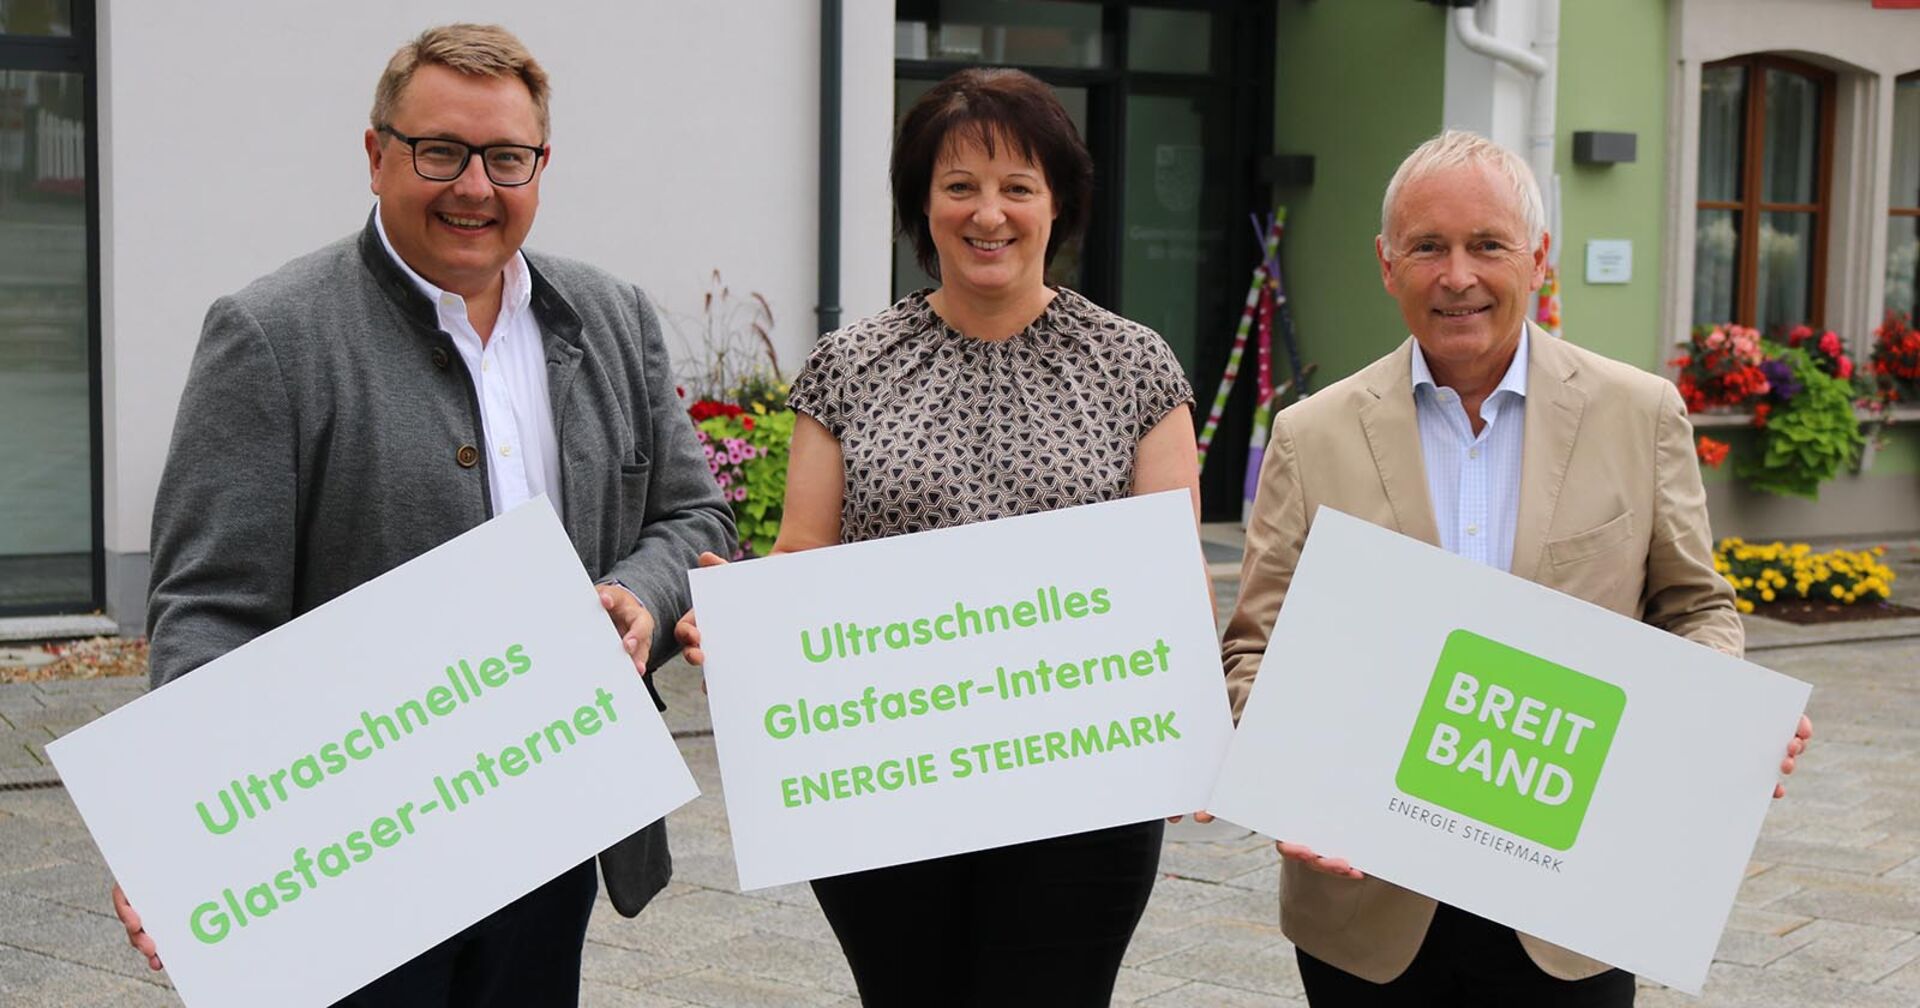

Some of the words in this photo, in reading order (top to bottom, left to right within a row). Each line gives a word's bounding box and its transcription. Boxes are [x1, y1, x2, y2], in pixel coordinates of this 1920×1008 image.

[801, 586, 1111, 663] Ultraschnelles
[763, 639, 1169, 740] Glasfaser-Internet
[1444, 671, 1596, 755] BREIT
[196, 644, 530, 835] Ultraschnelles
[782, 753, 938, 808] ENERGIE
[949, 711, 1181, 779] STEIERMARK
[1426, 722, 1573, 806] BAND
[191, 690, 616, 944] Glasfaser-Internet
[1388, 797, 1458, 834] ENERGIE
[1462, 825, 1564, 874] STEIERMARK
